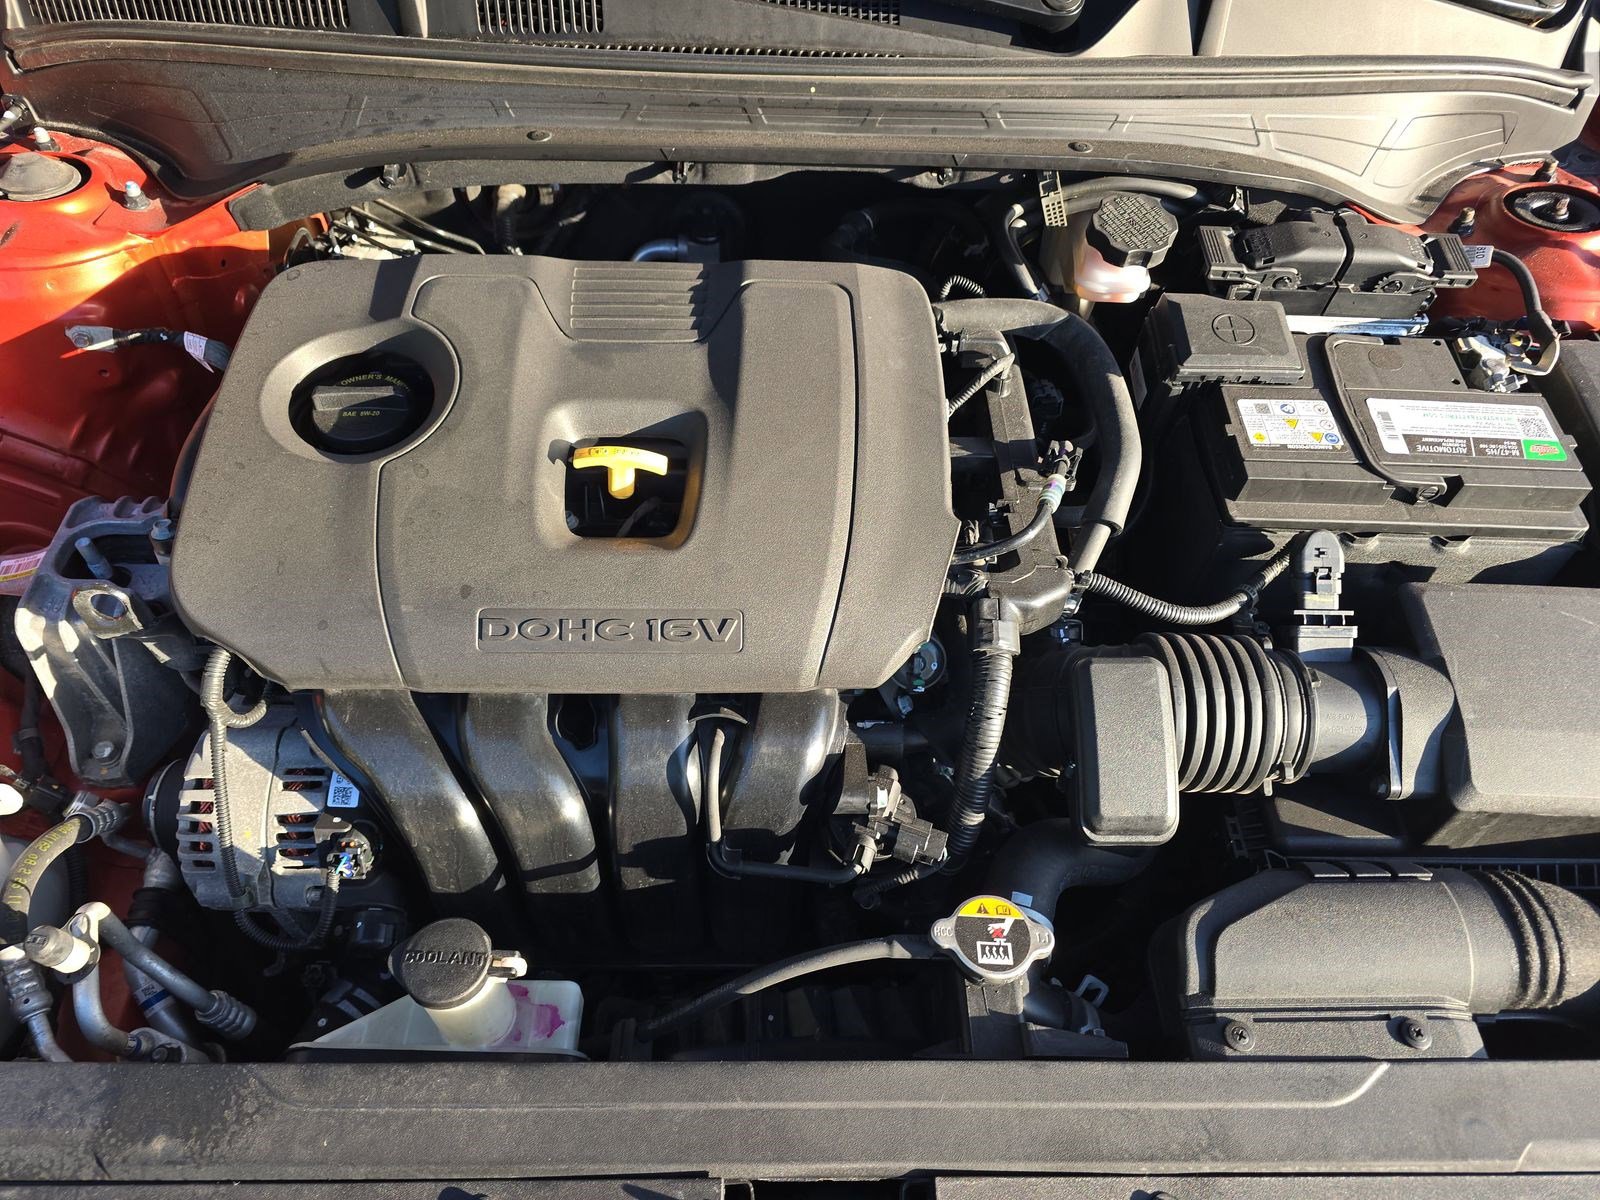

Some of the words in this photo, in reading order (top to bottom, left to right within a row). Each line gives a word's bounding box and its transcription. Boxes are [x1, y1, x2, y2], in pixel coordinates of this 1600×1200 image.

[341, 374, 383, 386] OWNER'S
[1416, 444, 1468, 454] AUTOMOTIVE
[478, 617, 636, 643] DOHC
[645, 617, 739, 643] 16V
[404, 950, 489, 967] COOLANT
